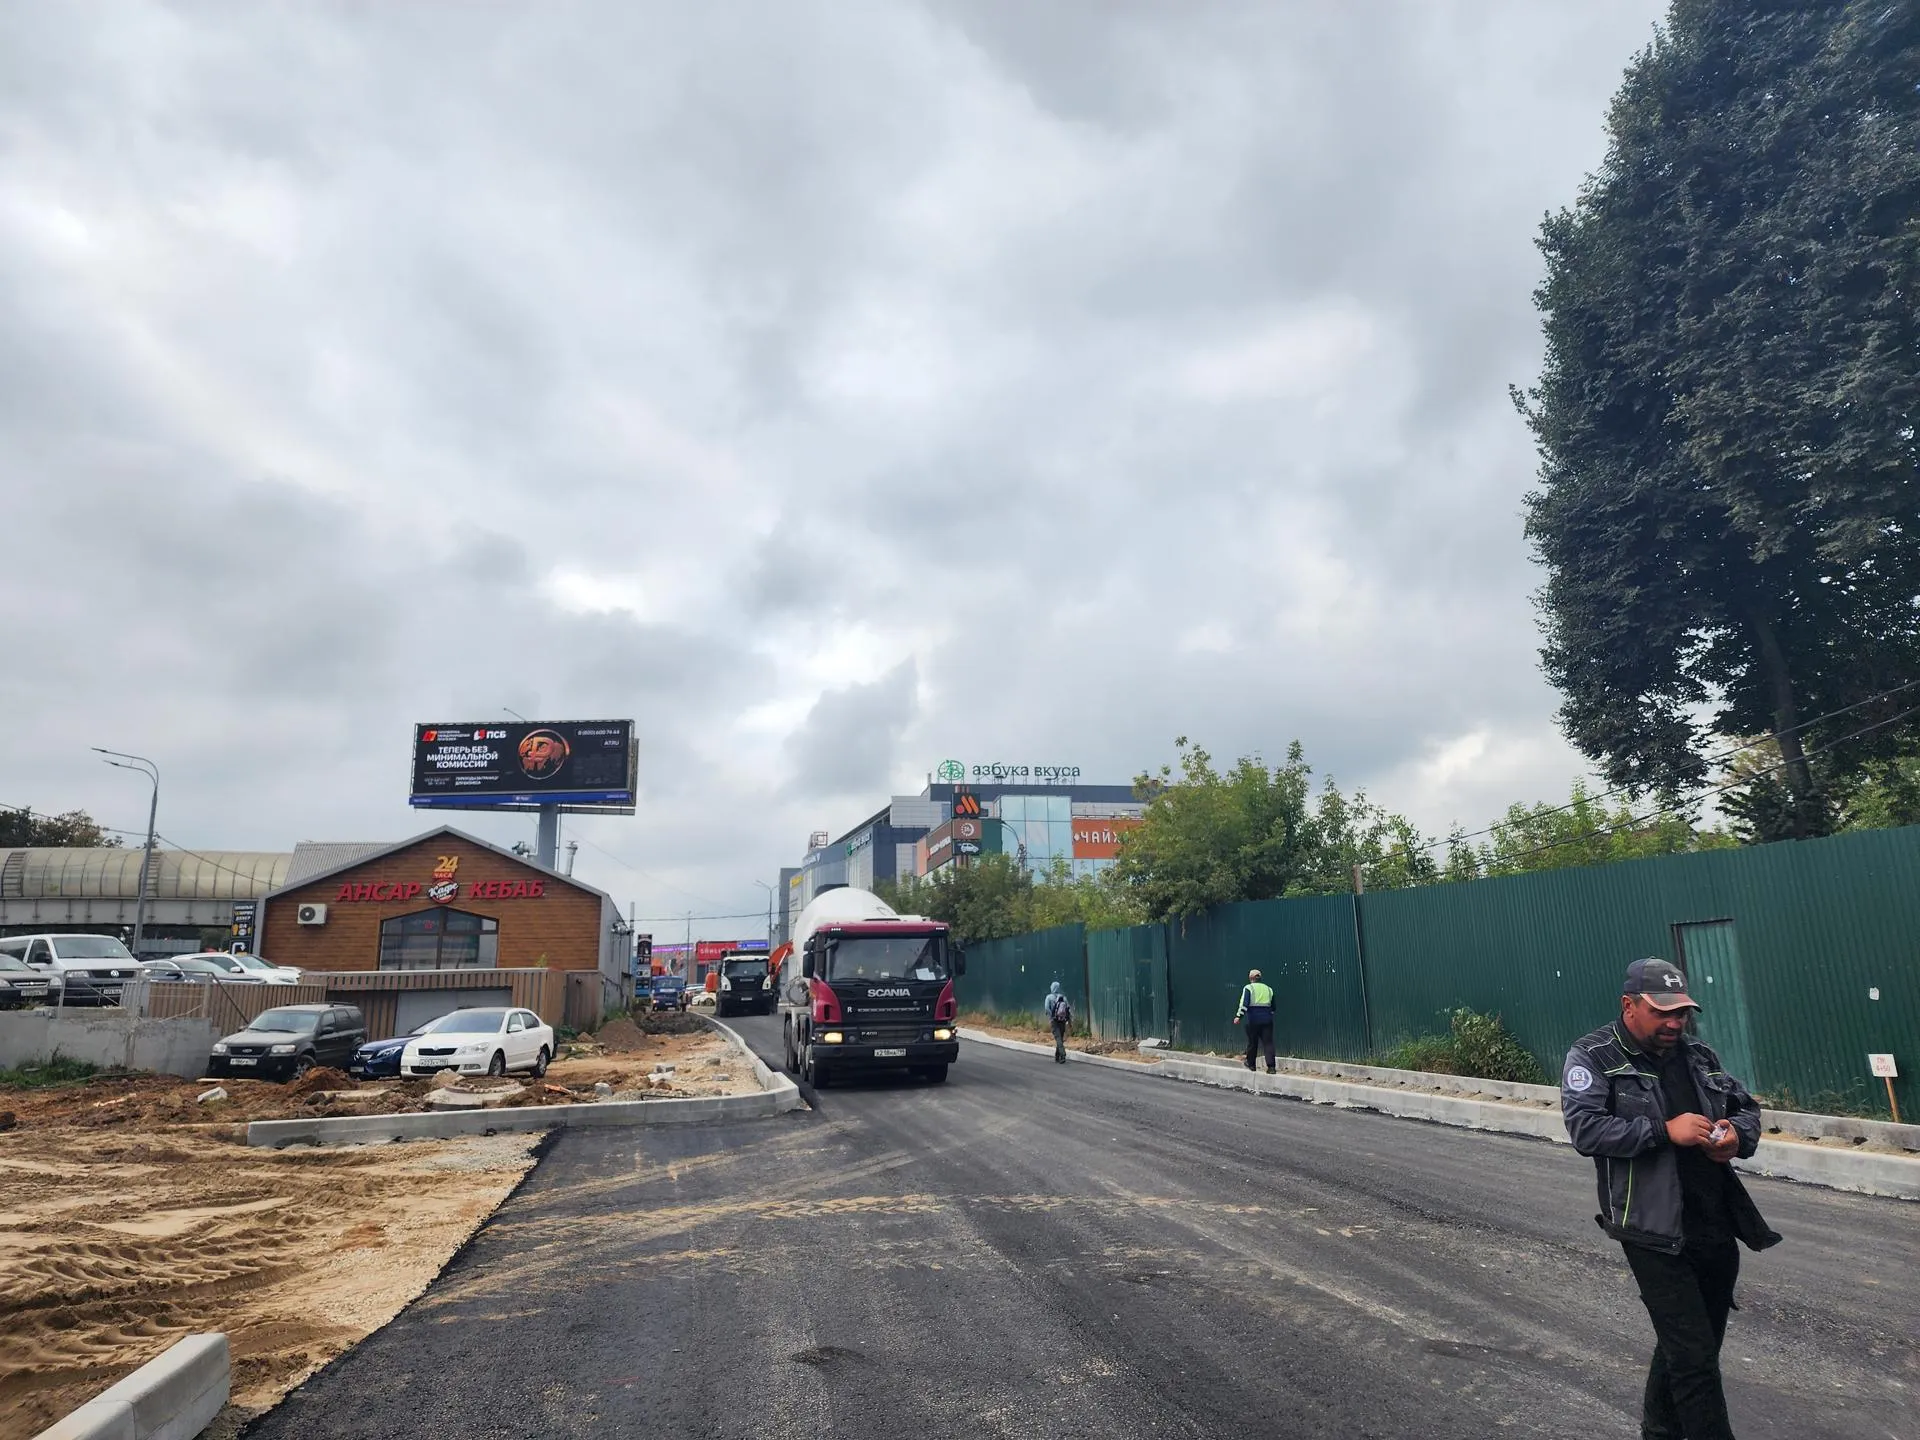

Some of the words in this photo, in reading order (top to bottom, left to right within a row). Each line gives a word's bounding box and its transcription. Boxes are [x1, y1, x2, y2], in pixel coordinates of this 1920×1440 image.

[486, 730, 507, 739] ПСБ
[438, 746, 471, 754] ТЕПЕРЬ
[426, 751, 499, 761] МИНИМАЛЬНОЙ
[436, 760, 488, 768] КОМИССИИ
[972, 761, 1029, 779] азбука
[1034, 766, 1081, 780] вкуса
[434, 855, 459, 872] 24
[336, 881, 421, 901] АНСАР
[468, 879, 543, 899] КЕБАБ
[867, 989, 911, 997] SCANIA
